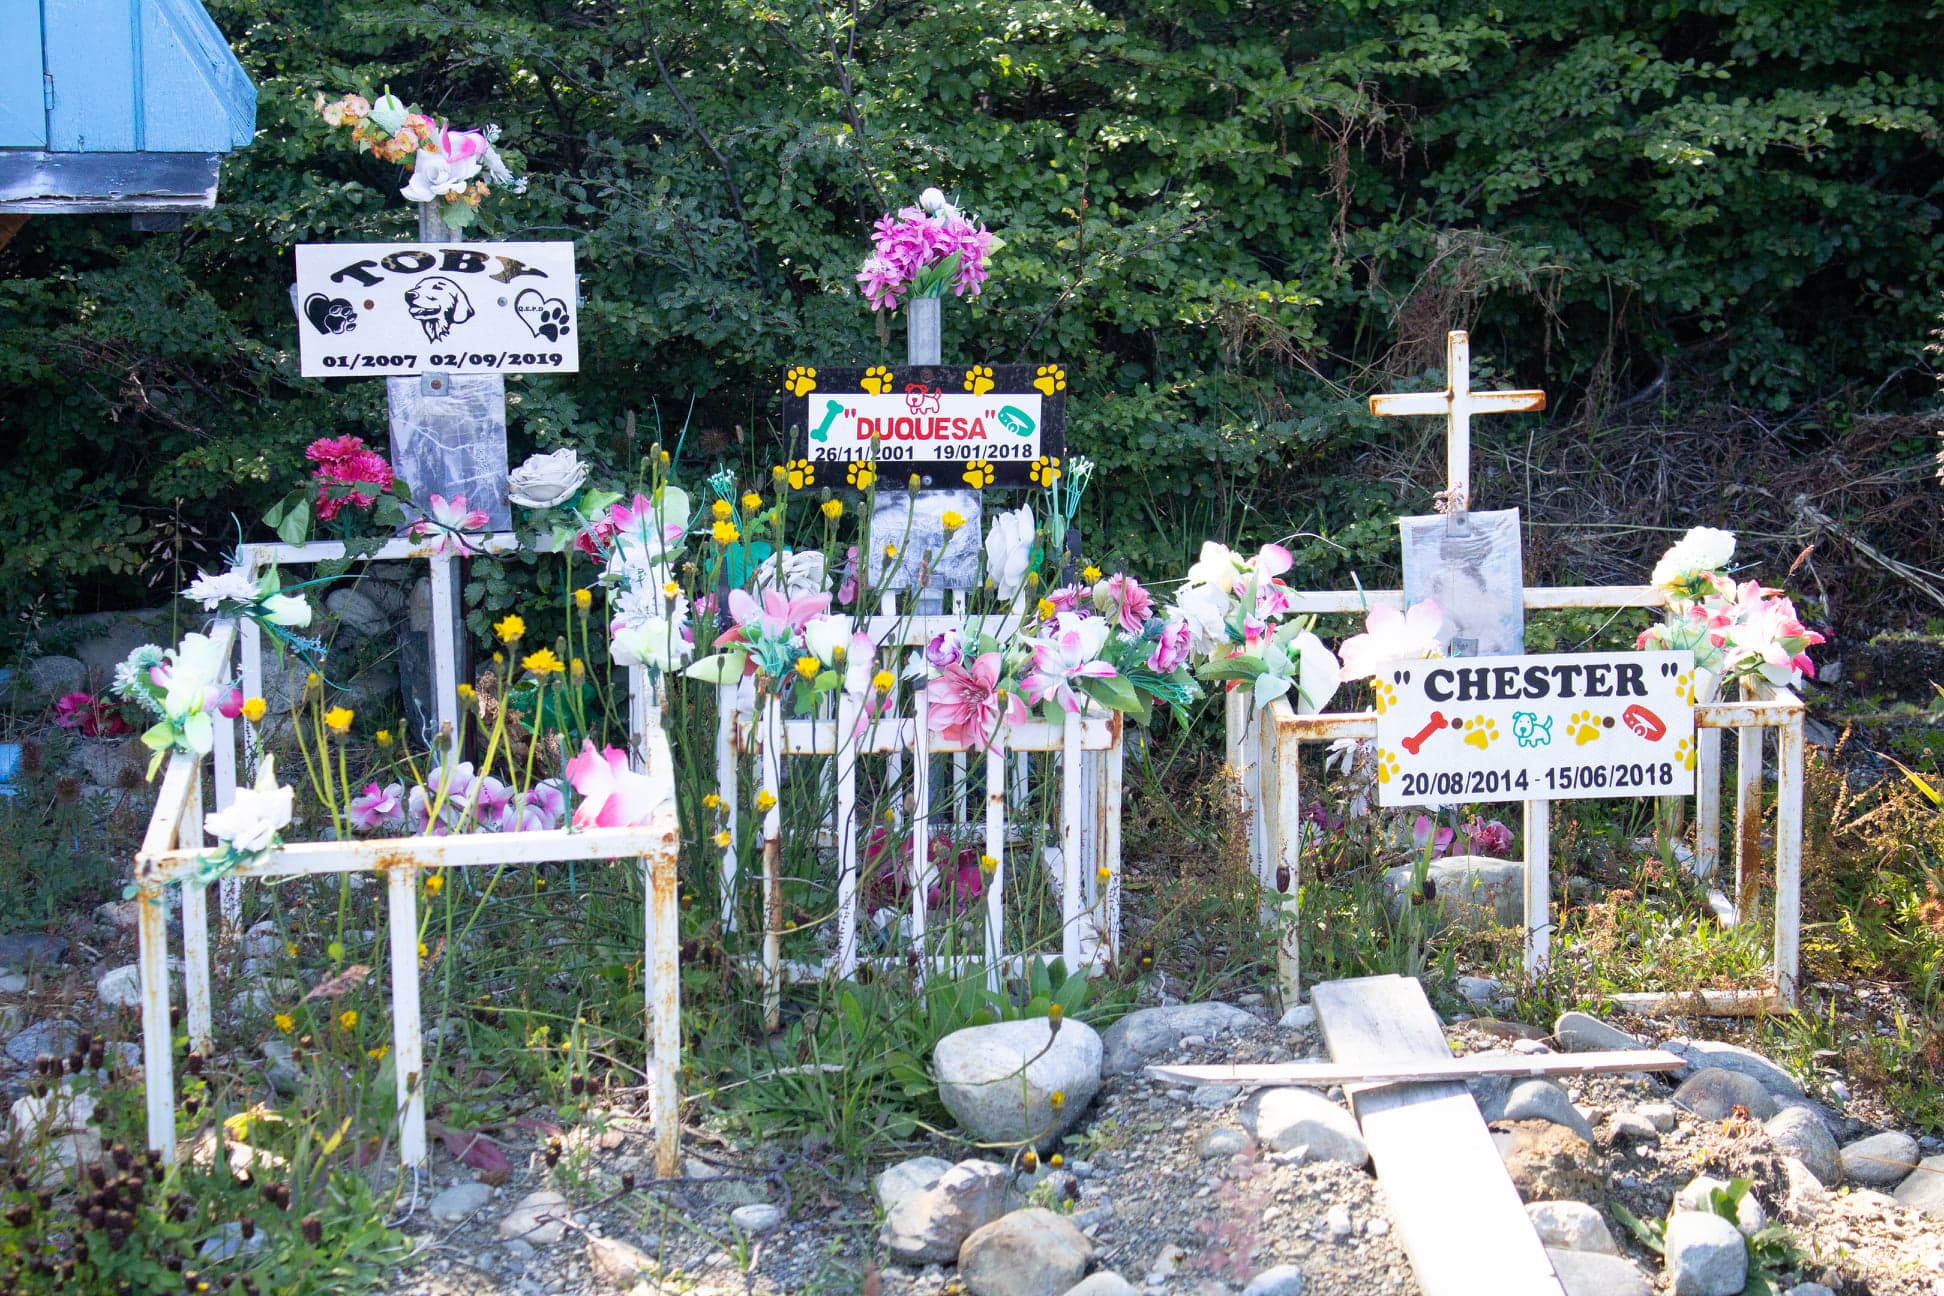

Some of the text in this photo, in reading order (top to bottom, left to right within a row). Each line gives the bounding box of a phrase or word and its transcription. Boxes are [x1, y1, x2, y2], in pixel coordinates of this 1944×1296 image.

[330, 249, 549, 287] TOBY
[322, 352, 563, 370] 01/2007 02/09/2019
[844, 408, 996, 441] "DUQUESA"
[933, 444, 1032, 460] 19/01/2018
[1424, 663, 1648, 701] CHESTER
[1401, 769, 1529, 796] 20/08/2014
[1545, 762, 1673, 790] 15/06/2018
